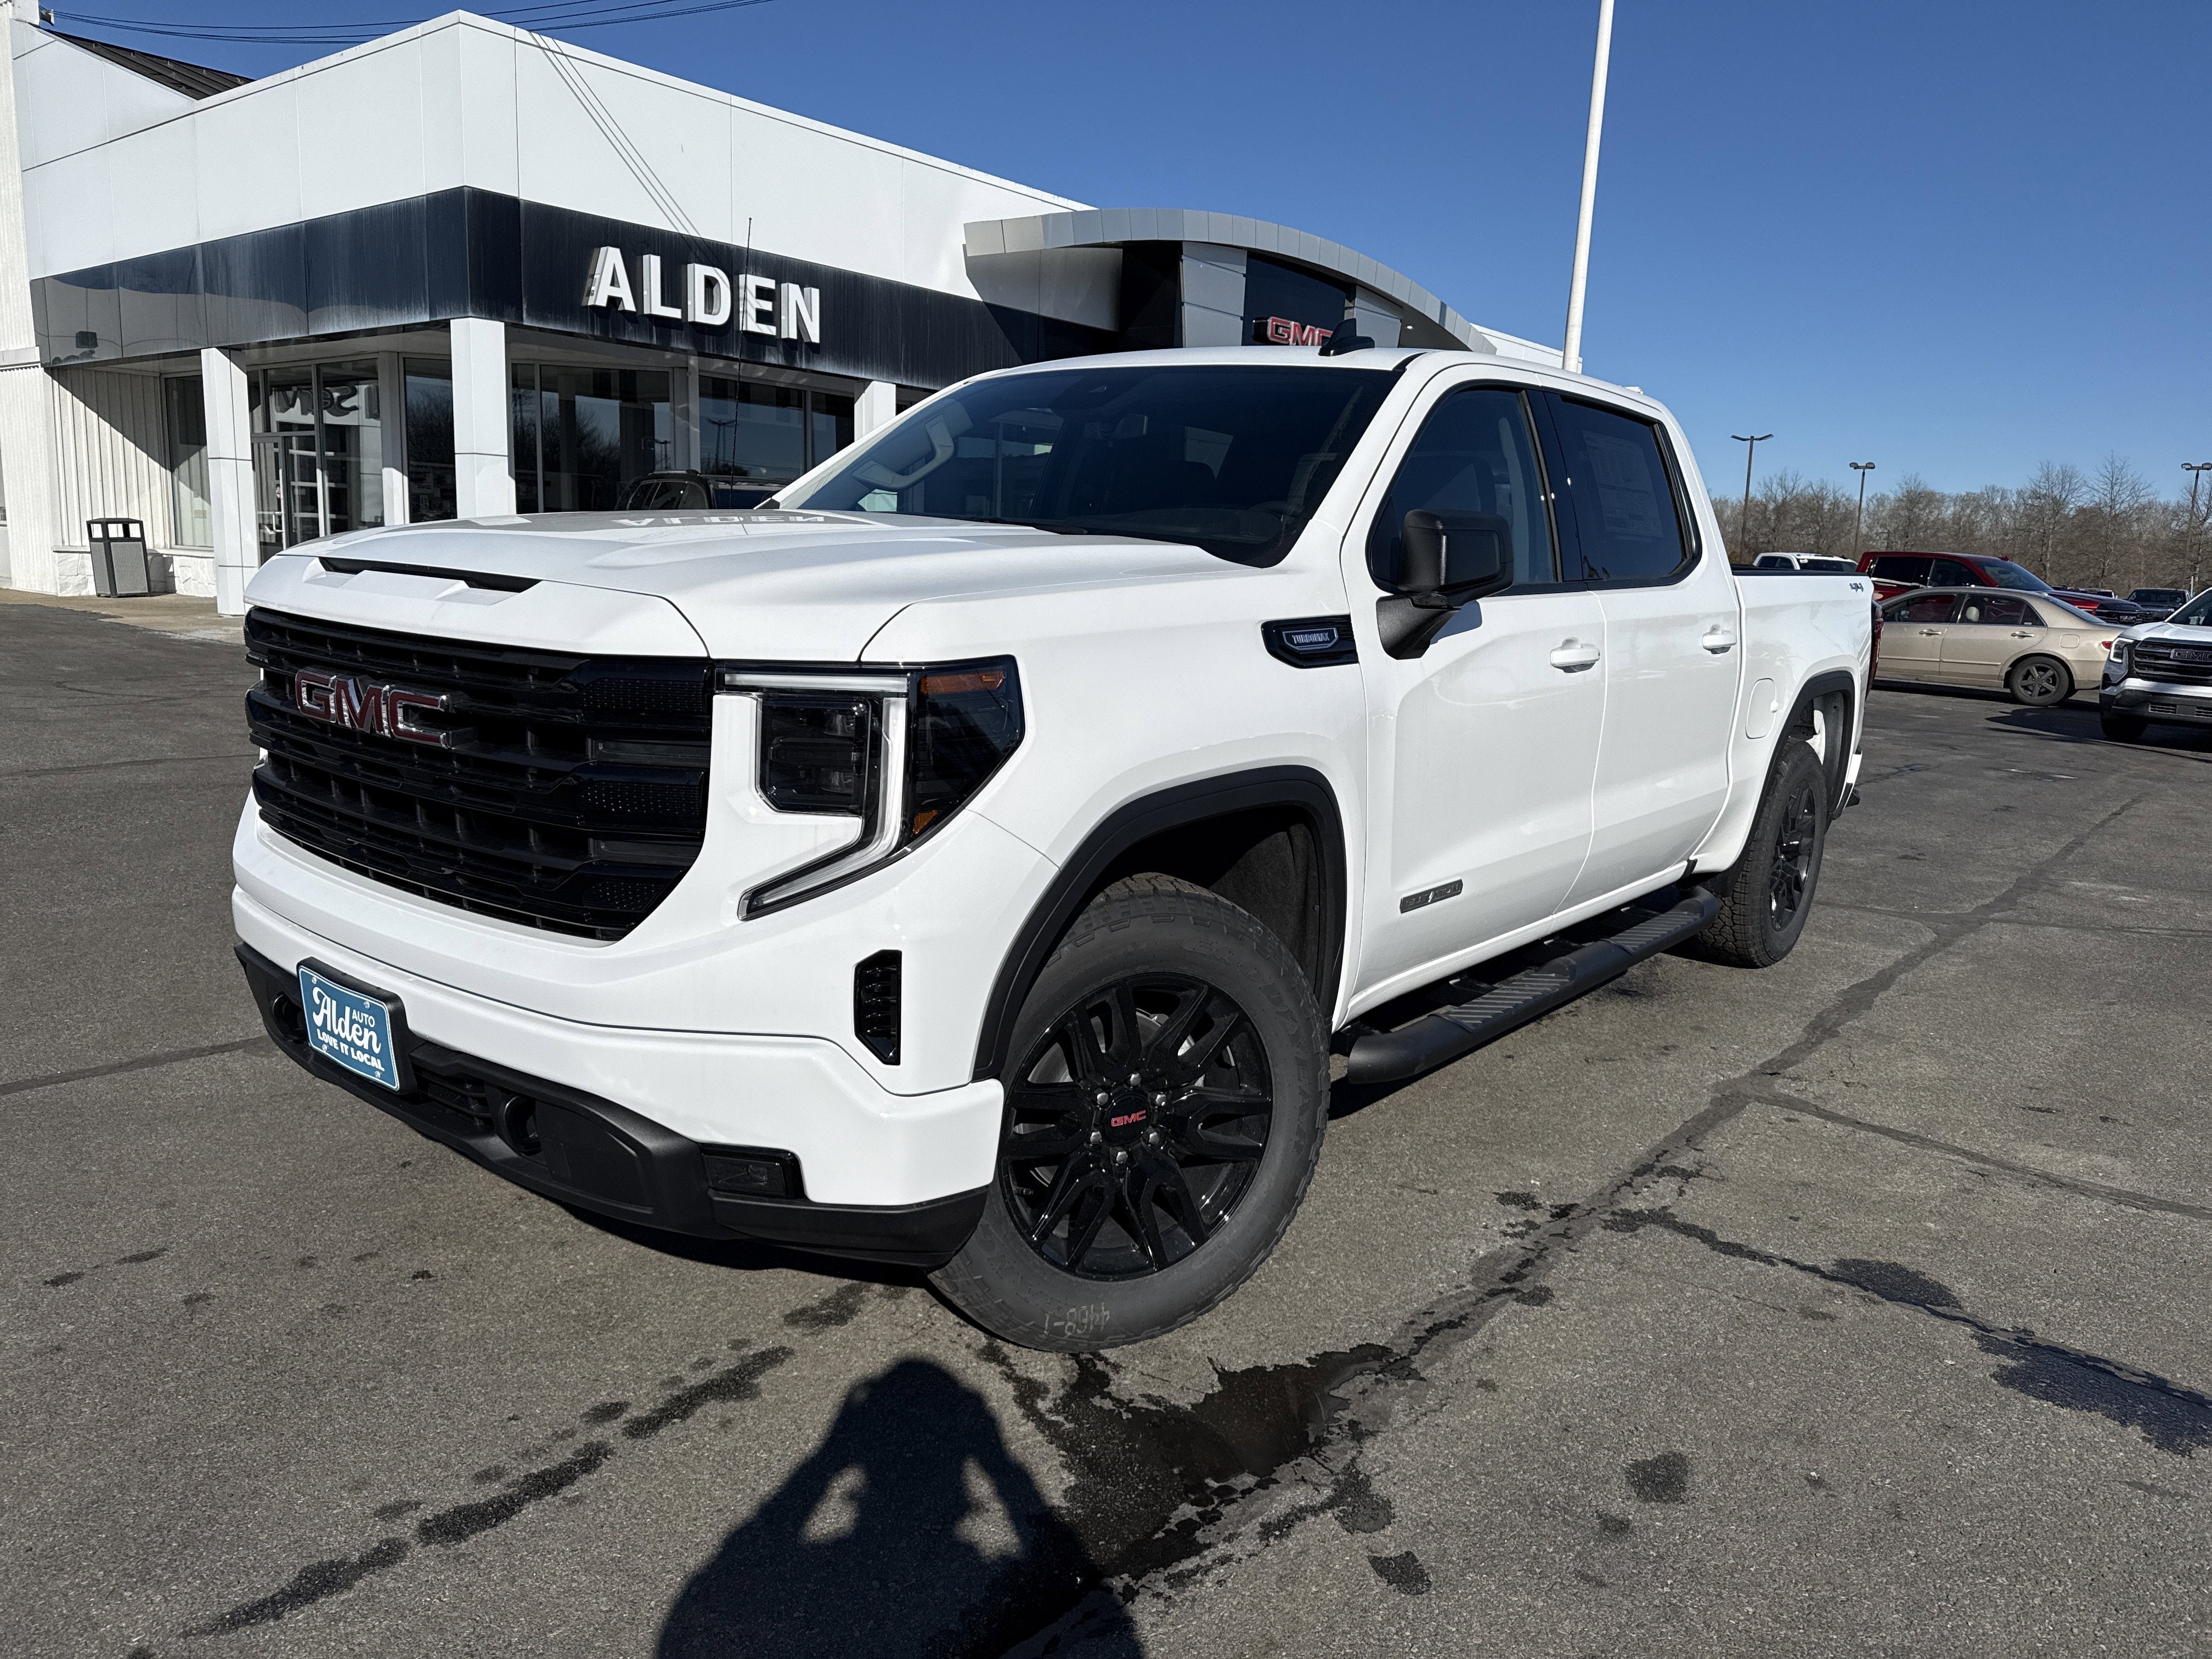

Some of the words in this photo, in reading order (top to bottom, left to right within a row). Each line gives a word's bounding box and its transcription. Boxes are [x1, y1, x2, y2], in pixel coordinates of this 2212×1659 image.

[586, 245, 820, 344] ALDEN
[295, 669, 451, 749] GMC
[312, 986, 381, 1054] Alden
[352, 1009, 375, 1028] AUTO
[317, 1028, 339, 1049] LOVE
[340, 1041, 349, 1055] IT
[350, 1047, 385, 1071] LOCAL
[1111, 1110, 1147, 1127] GMC
